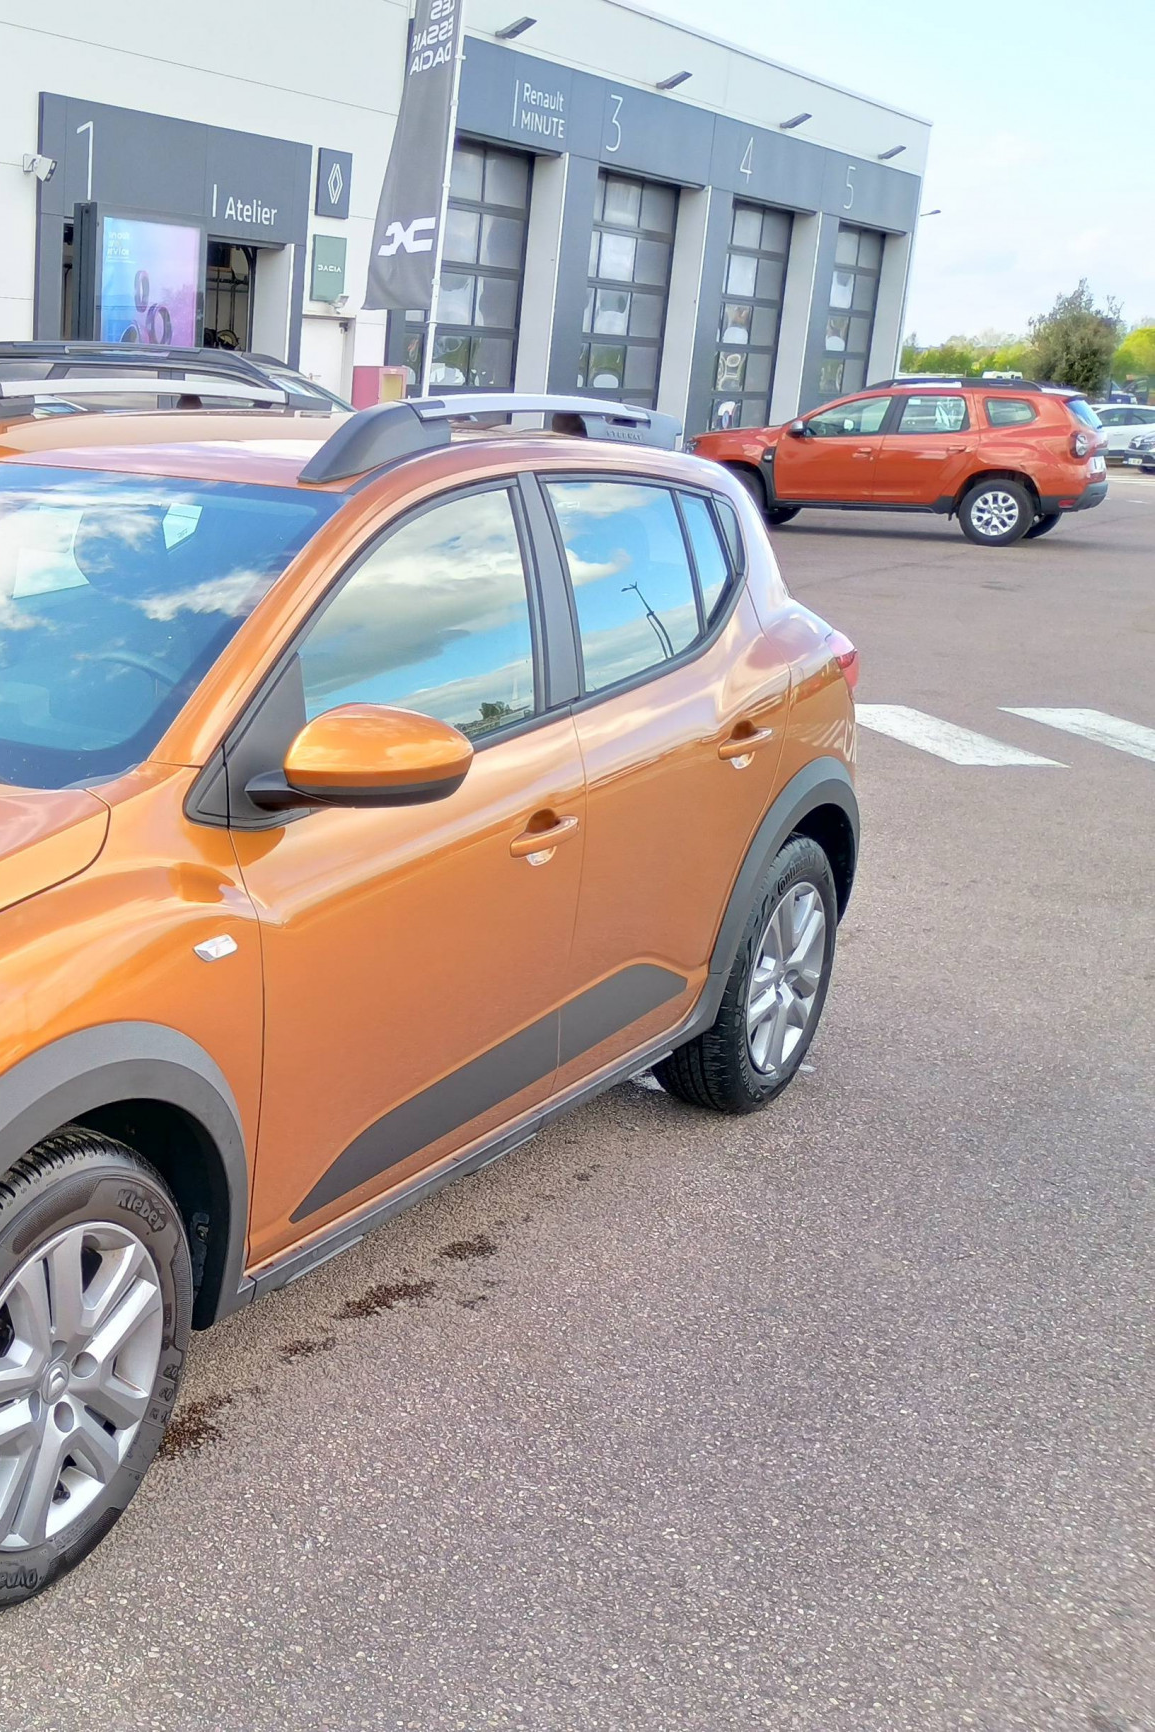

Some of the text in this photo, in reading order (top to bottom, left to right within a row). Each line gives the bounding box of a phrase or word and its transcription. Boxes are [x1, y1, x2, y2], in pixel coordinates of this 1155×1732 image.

[523, 82, 564, 112] Renault
[521, 109, 565, 139] MINUTE
[606, 94, 623, 152] 3
[76, 120, 94, 201] 1
[739, 137, 753, 184] 4
[843, 165, 856, 209] 5
[224, 196, 278, 226] Atelier
[317, 264, 342, 273] DACIA
[117, 1189, 167, 1232] Kleber
